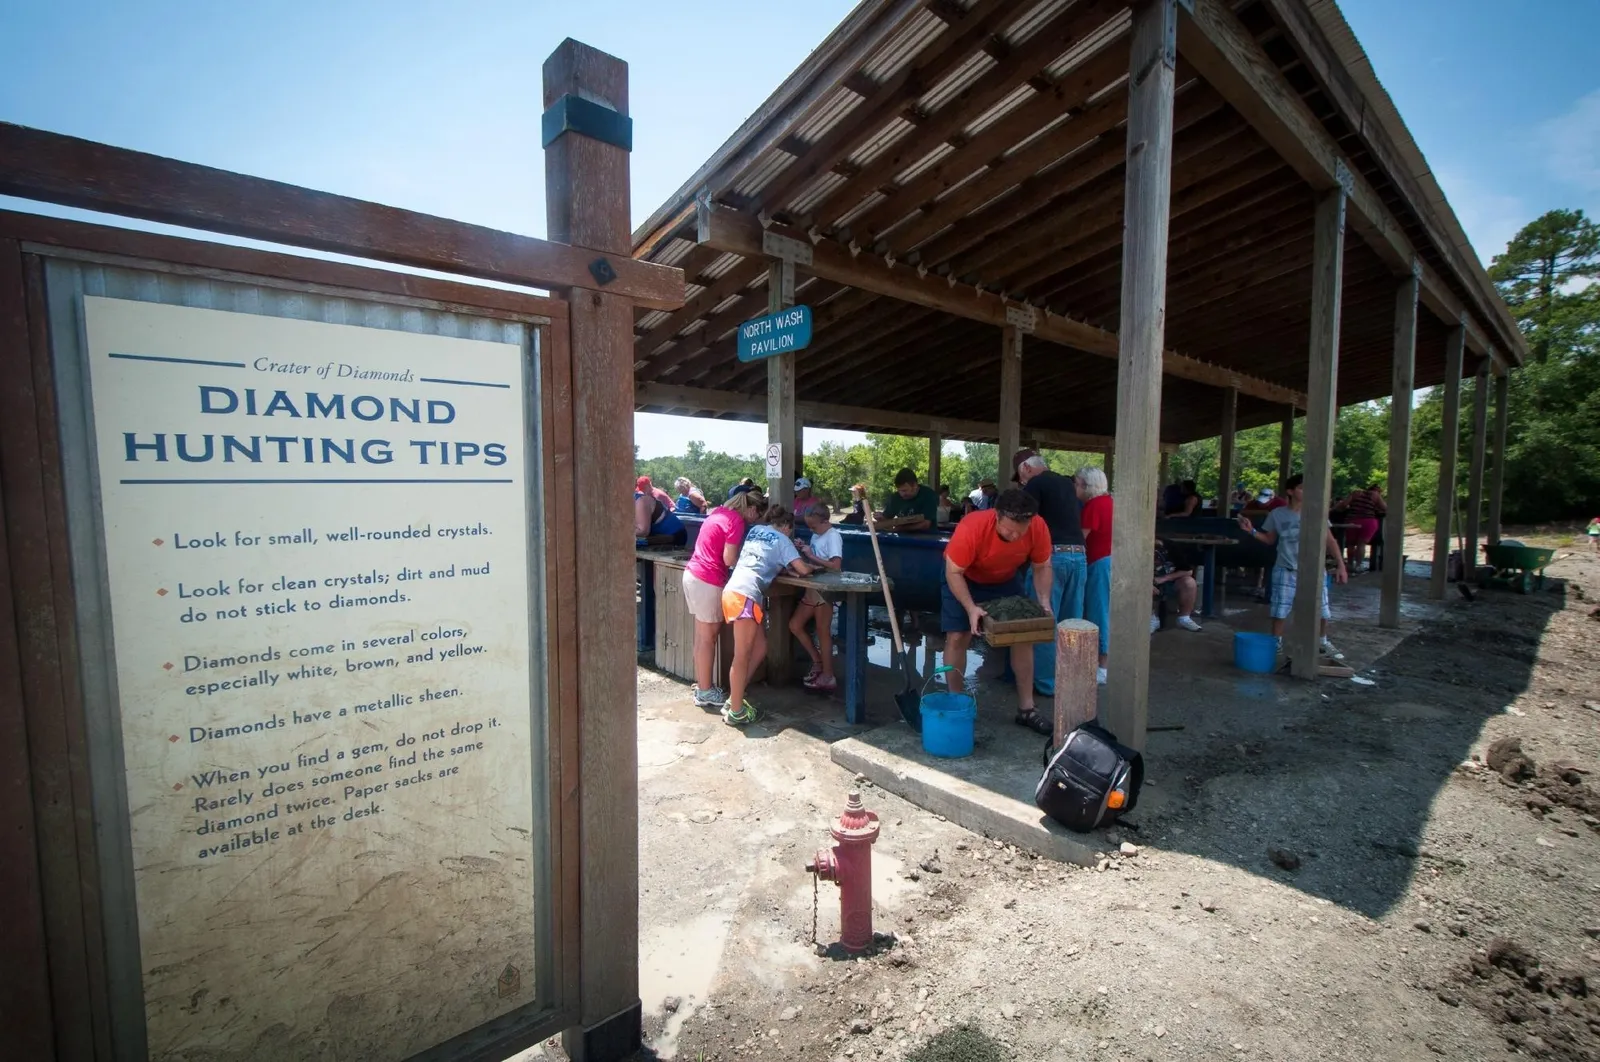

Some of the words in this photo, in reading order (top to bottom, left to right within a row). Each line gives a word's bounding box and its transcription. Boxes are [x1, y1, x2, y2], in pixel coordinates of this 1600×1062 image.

[743, 319, 772, 339] NORTH
[775, 310, 803, 330] WASH
[751, 333, 794, 355] PAVILION
[253, 356, 311, 376] Crater
[316, 362, 334, 381] of
[336, 363, 415, 383] Diamonds
[198, 385, 456, 424] DIAMOND
[122, 432, 394, 464] HUNTING
[409, 439, 508, 466] TIPS
[174, 530, 227, 550] Look
[235, 529, 261, 547] for
[268, 528, 319, 546] small,
[326, 524, 431, 542] well-rounded
[437, 522, 493, 539] crystals.
[178, 580, 230, 600] Look
[238, 578, 264, 596] for
[271, 575, 317, 592] clean
[324, 569, 391, 589] crystals;
[396, 567, 423, 582] dirt
[428, 564, 455, 579] and
[461, 562, 490, 576] mud
[180, 607, 207, 624] do
[216, 605, 248, 620] not
[256, 599, 297, 617] stick
[304, 599, 321, 612] to
[329, 590, 411, 609] diamonds.
[184, 646, 281, 672] Diamonds
[289, 642, 336, 658] come
[342, 638, 356, 651] in
[362, 630, 414, 649] several
[420, 626, 468, 642] colors,
[185, 670, 280, 698] especially
[287, 664, 338, 681] white,
[346, 657, 399, 673] brown,
[407, 648, 434, 664] and
[439, 644, 488, 661] yellow.
[189, 715, 285, 743] Diamonds
[292, 709, 331, 725] have
[338, 707, 347, 717] a
[354, 694, 413, 715] metallic
[419, 687, 463, 702] sheen.
[191, 769, 250, 789] When
[257, 762, 290, 779] you
[297, 749, 329, 767] find
[336, 749, 345, 760] a
[351, 743, 389, 759] gem,
[396, 731, 416, 748] do
[422, 728, 445, 743] not
[450, 721, 483, 737] drop
[488, 718, 502, 729] it.
[194, 789, 254, 813] Rarely
[262, 780, 304, 798] does
[311, 763, 383, 787] someone
[389, 751, 416, 768] find
[423, 747, 445, 762] the
[450, 741, 484, 755] same
[196, 805, 279, 836] diamond
[286, 796, 336, 815] twice.
[344, 782, 389, 800] Paper
[394, 771, 432, 789] sacks
[438, 766, 459, 777] are
[197, 828, 280, 859] available
[287, 823, 304, 837] at
[310, 815, 336, 830] the
[343, 805, 385, 821] desk.
